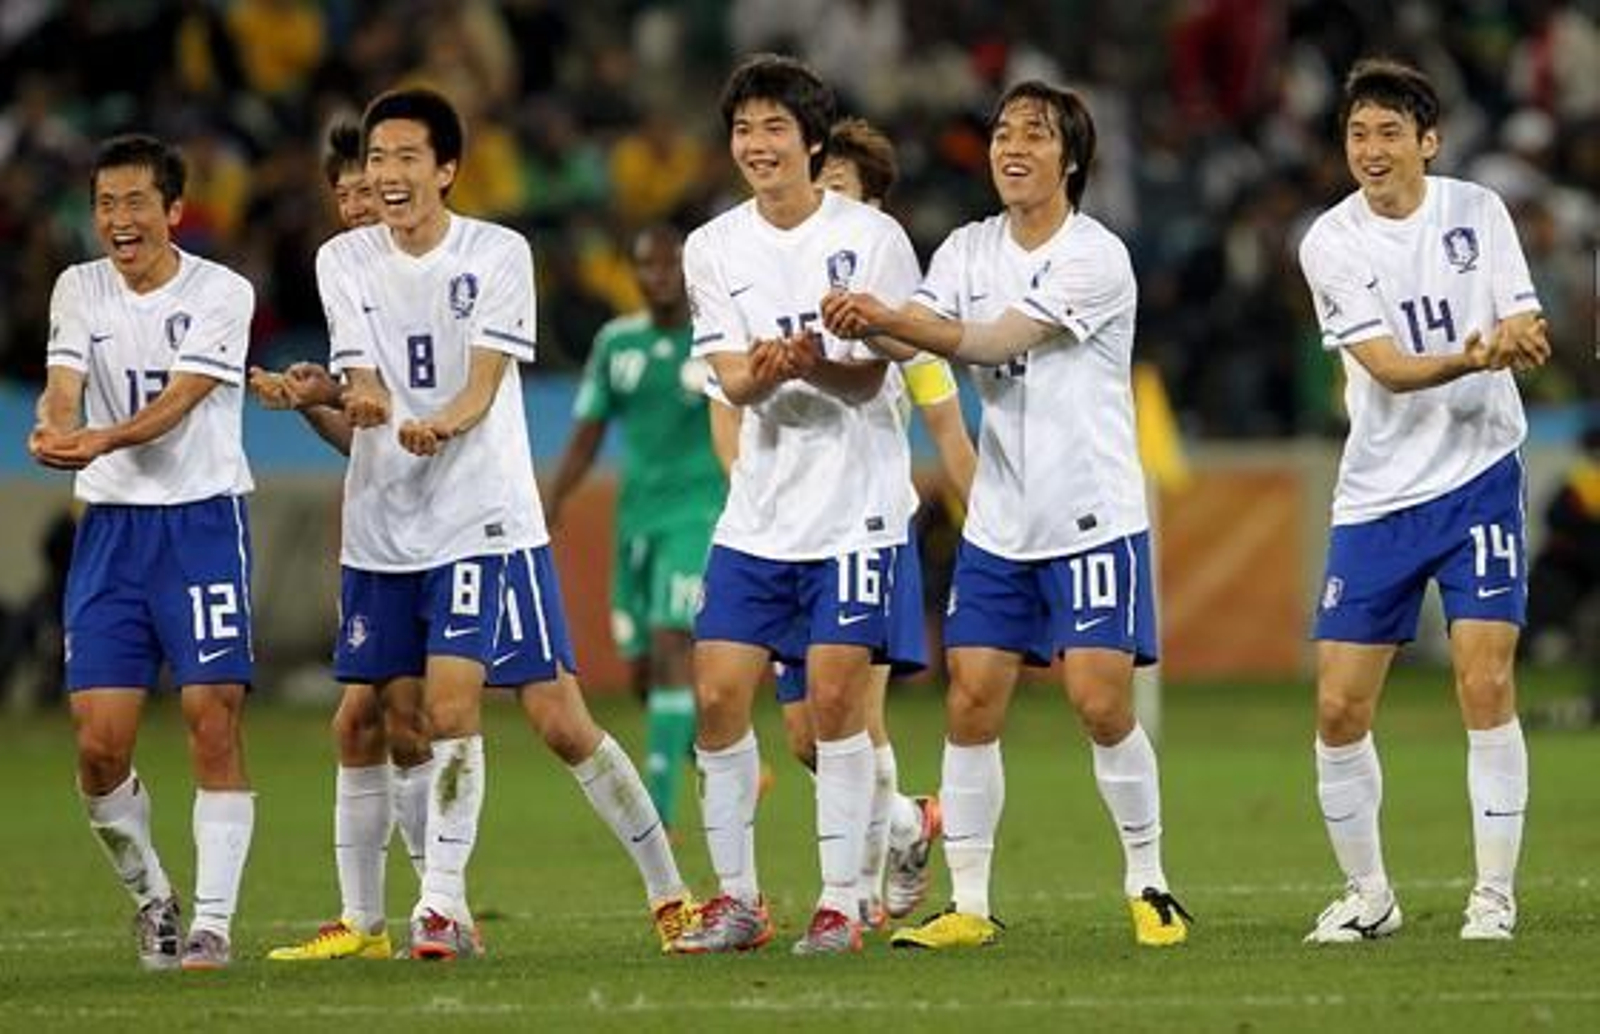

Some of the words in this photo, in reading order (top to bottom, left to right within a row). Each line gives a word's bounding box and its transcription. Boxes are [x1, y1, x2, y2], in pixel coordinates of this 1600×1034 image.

[1401, 296, 1456, 354] 14
[407, 334, 436, 388] 8
[125, 369, 169, 416] 12
[1469, 524, 1517, 577] 14
[451, 563, 480, 615] 8
[838, 551, 880, 604] 16
[1069, 553, 1117, 610] 10
[188, 584, 238, 639] 12
